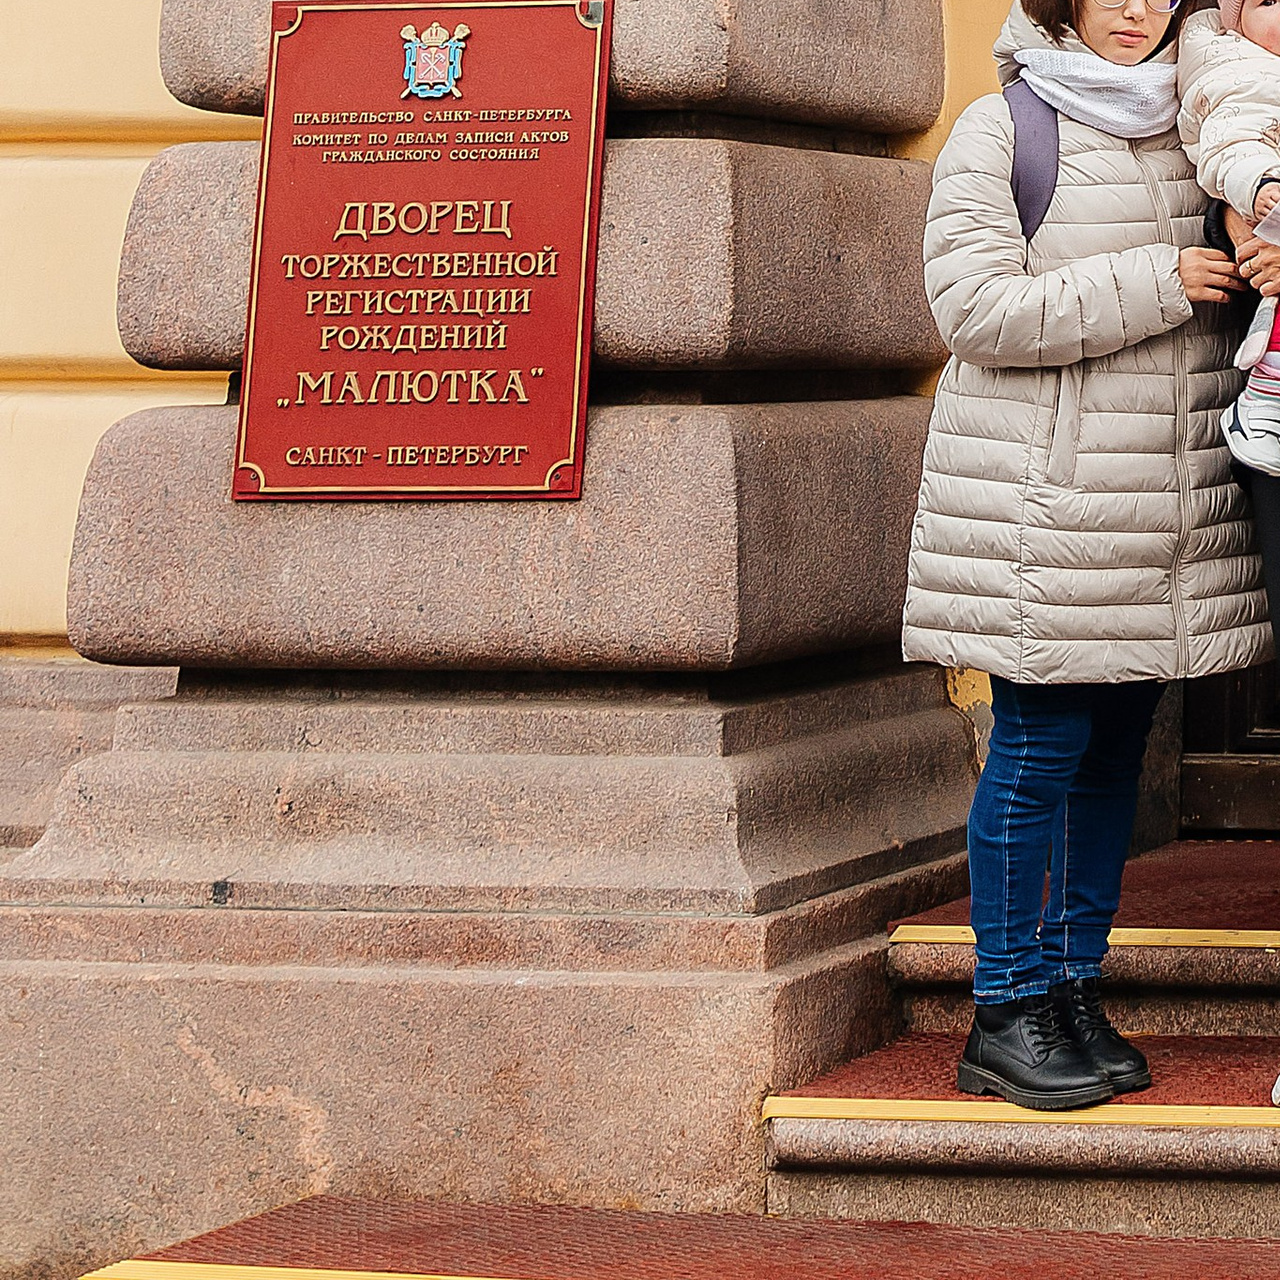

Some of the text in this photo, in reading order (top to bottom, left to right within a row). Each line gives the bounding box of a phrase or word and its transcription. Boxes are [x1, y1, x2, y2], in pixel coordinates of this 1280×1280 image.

[293, 108, 572, 125] ПРАВИТЕЛЬСТВО САНКТ-ПЕТЕРБУРГА
[292, 130, 569, 146] КОМИТЕТ ПО ДЕЛАМ ЗАПИСИ АКТОВ
[322, 147, 540, 163] ГРАЖДАНСКОГО СОСТОЯНИЯ
[332, 200, 513, 241] ДВОРЕЦ
[280, 245, 559, 278] ТОРЖЕСТВЕННОЙ
[305, 288, 533, 318] РЕГИСТРАЦИИ
[319, 318, 509, 354] РОЖДЕНИЙ
